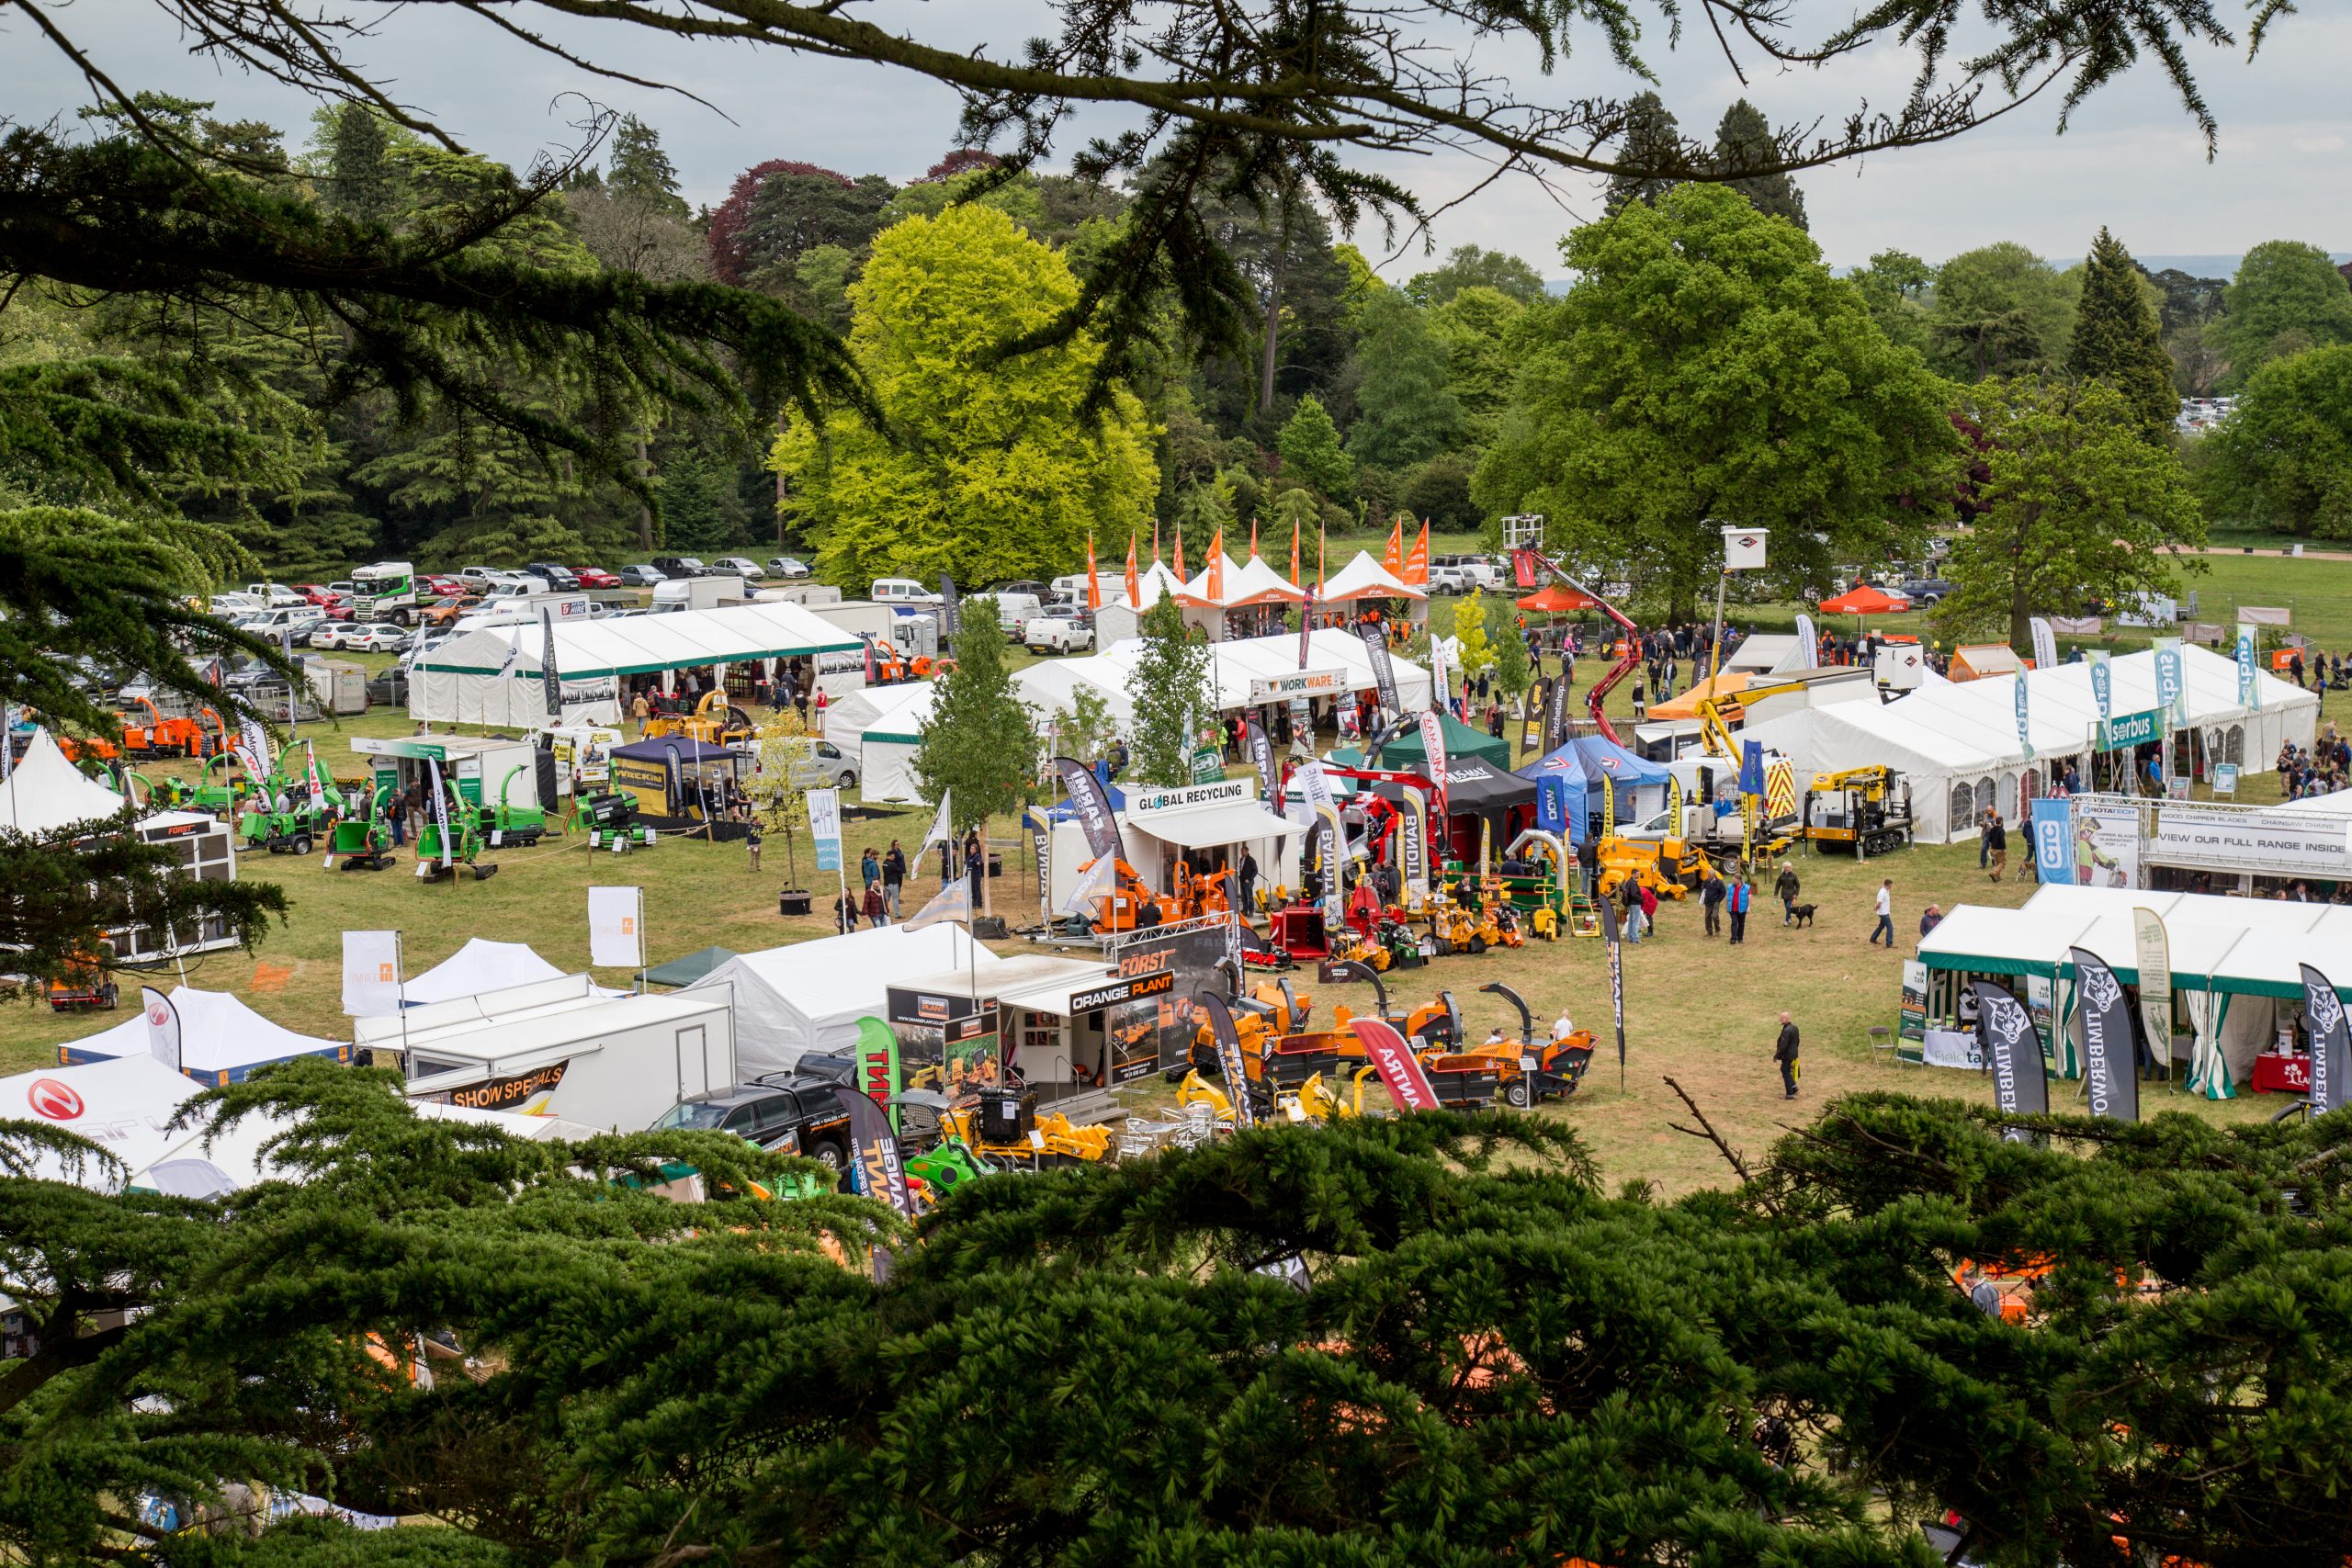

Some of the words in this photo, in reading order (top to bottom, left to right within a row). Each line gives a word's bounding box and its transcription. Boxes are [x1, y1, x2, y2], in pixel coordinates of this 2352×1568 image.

[570, 606, 586, 615] HIRE
[1280, 674, 1332, 693] WORKWARE
[1553, 685, 1566, 739] ratchetshop
[1527, 721, 1542, 731] BIG
[2112, 716, 2151, 742] sorbus
[1446, 766, 1490, 784] MUS-MAX
[1139, 791, 1183, 811] GLOBAL
[1187, 784, 1242, 804] RECYCLING
[1546, 788, 1559, 821] DOW
[2218, 817, 2247, 825] BLADES
[2261, 819, 2303, 828] CHAINSAW
[2305, 822, 2335, 830] CHAINS
[168, 825, 196, 836] FÖRST
[2159, 832, 2190, 842] VIEW
[2195, 835, 2220, 844] OUR
[2224, 837, 2253, 847] FULL
[2257, 840, 2301, 851] RANGE
[2305, 843, 2346, 853] INSIDE
[1120, 949, 1176, 978] FÖRST
[1914, 976, 1925, 984] talk
[1073, 986, 1129, 1010] ORANGE
[1132, 976, 1172, 997] PLANT
[2039, 989, 2050, 999] talk
[922, 998, 945, 1007] ORANGE
[922, 1004, 946, 1012] PLANT
[455, 1085, 503, 1107] SHOW
[505, 1066, 562, 1100] SPECIALS
